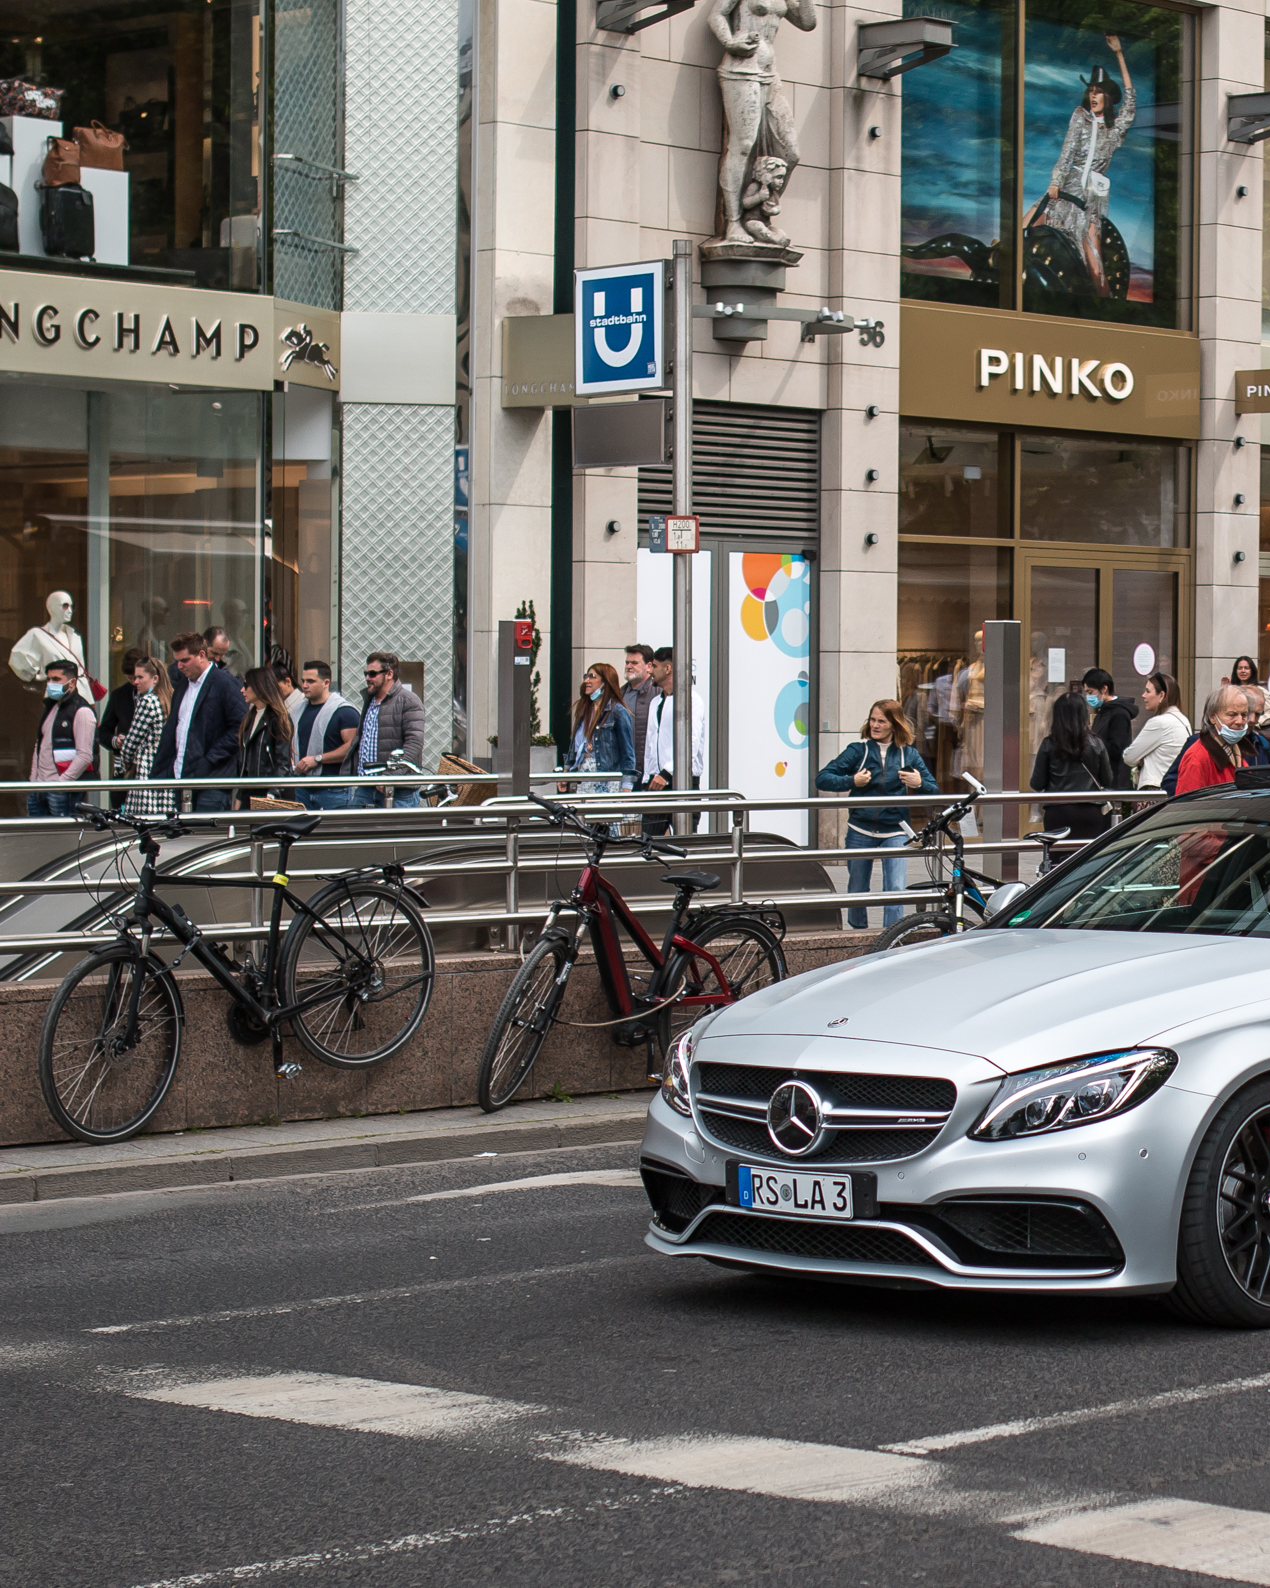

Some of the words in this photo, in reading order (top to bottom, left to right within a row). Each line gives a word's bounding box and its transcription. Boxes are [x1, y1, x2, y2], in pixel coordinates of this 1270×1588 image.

[589, 313, 647, 328] stadtbahn
[980, 348, 1135, 400] PINKO
[673, 520, 690, 529] H200
[752, 1173, 779, 1206] RS
[792, 1178, 827, 1211] LA
[832, 1181, 848, 1212] 3
